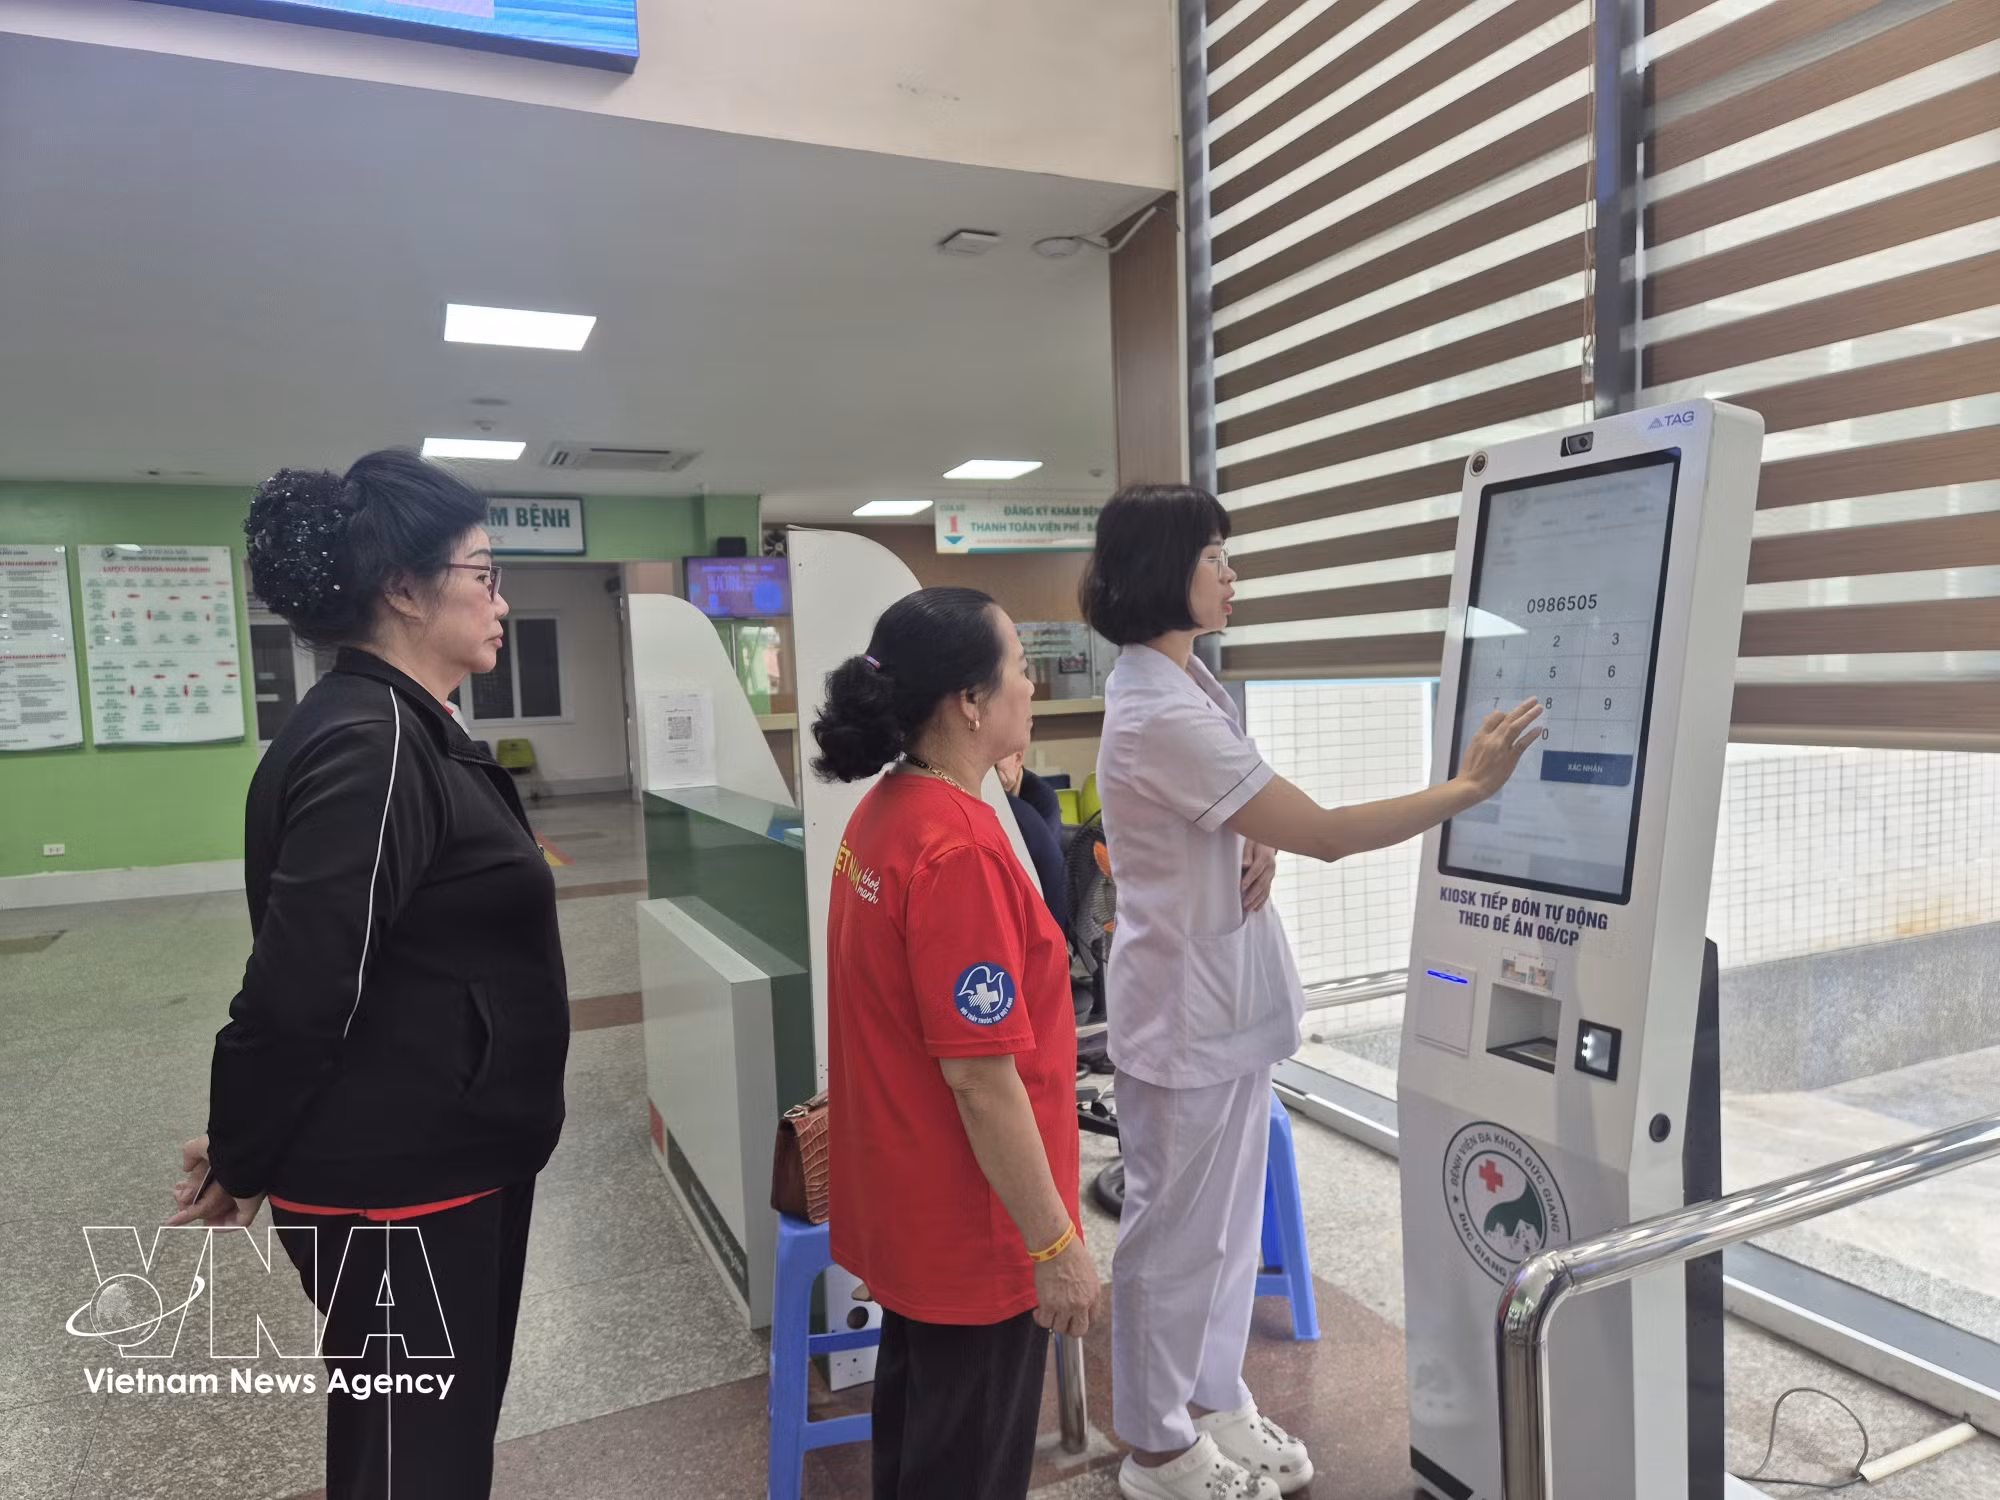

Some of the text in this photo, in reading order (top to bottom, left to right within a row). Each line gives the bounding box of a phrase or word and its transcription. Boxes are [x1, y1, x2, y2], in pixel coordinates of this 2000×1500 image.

[1664, 411, 1694, 426] TAG
[1004, 505, 1034, 516] ĐĂNG
[1051, 504, 1080, 516] KHÁM
[1082, 505, 1104, 517] BỆN
[515, 503, 570, 532] BỆNH
[949, 514, 958, 533] 1
[971, 522, 1007, 532] THANH
[1008, 520, 1036, 532] TOÁN
[1038, 520, 1061, 533] VIỆN
[1527, 593, 1598, 614] 0986505
[1553, 635, 1561, 648] 2
[1612, 632, 1620, 645] 3
[1496, 667, 1503, 679] 4
[1549, 666, 1556, 679] 5
[1608, 665, 1616, 678] 6
[1493, 697, 1500, 708] 7
[1545, 697, 1553, 709] 8
[1604, 698, 1612, 711] 9
[1541, 728, 1549, 740] 0
[1567, 762, 1581, 771] XÁC
[1440, 886, 1608, 930] KIOSK TIẾP ĐÓN TỰ ĐỘNG
[1459, 909, 1489, 929] THEO
[1513, 917, 1533, 938] ÁN
[1537, 923, 1579, 946] 06/CP
[1450, 1132, 1560, 1233] BỆNH VIỆN ĐA KHOA ĐỨC GIANG
[1474, 1243, 1507, 1278] GIANG
